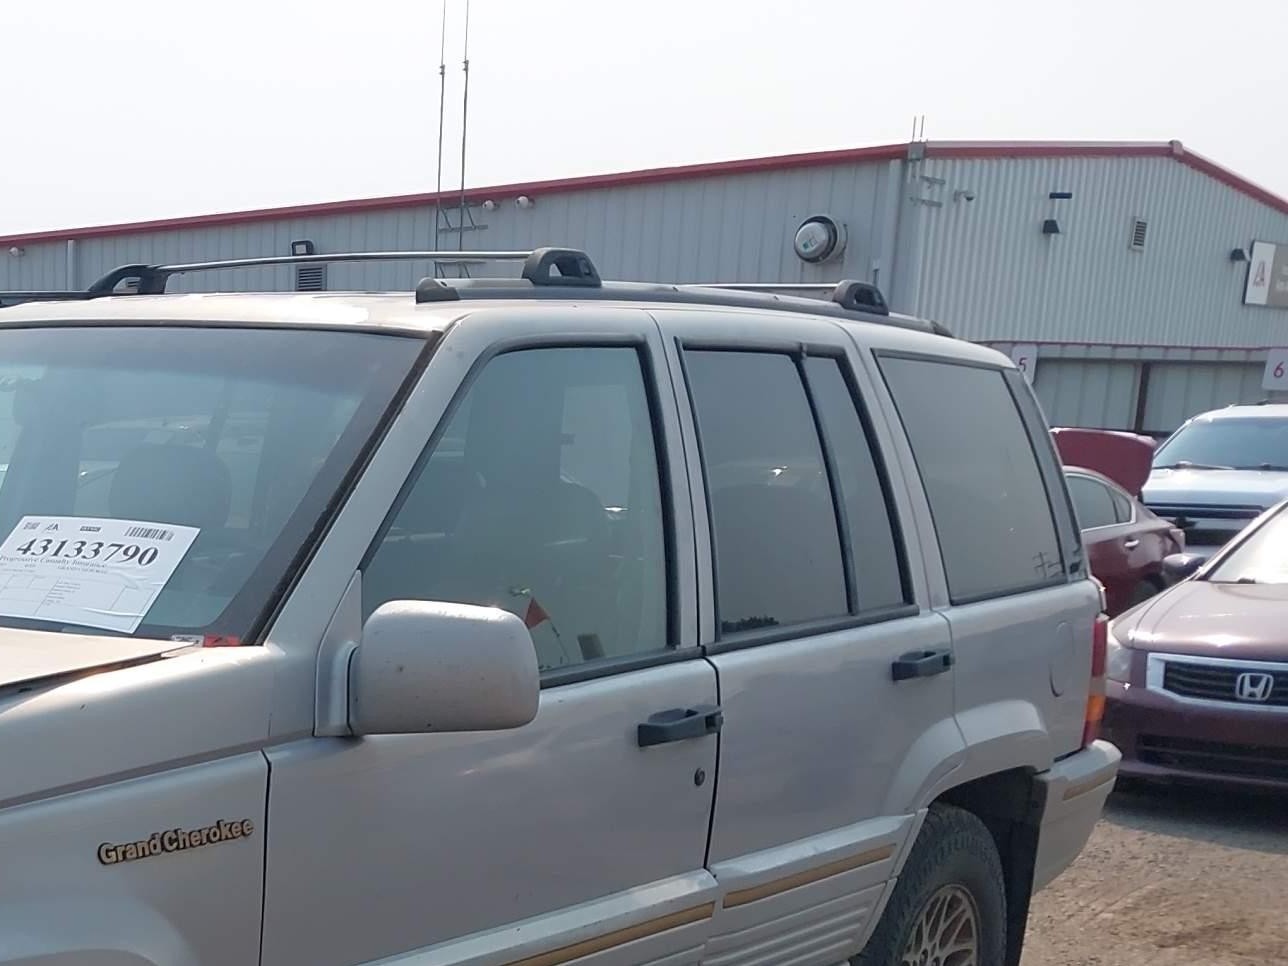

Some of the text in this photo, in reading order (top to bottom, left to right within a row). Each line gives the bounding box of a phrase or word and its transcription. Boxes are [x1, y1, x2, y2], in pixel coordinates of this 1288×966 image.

[1018, 357, 1028, 372] 5
[1273, 361, 1285, 378] 6
[16, 538, 159, 566] 43133790
